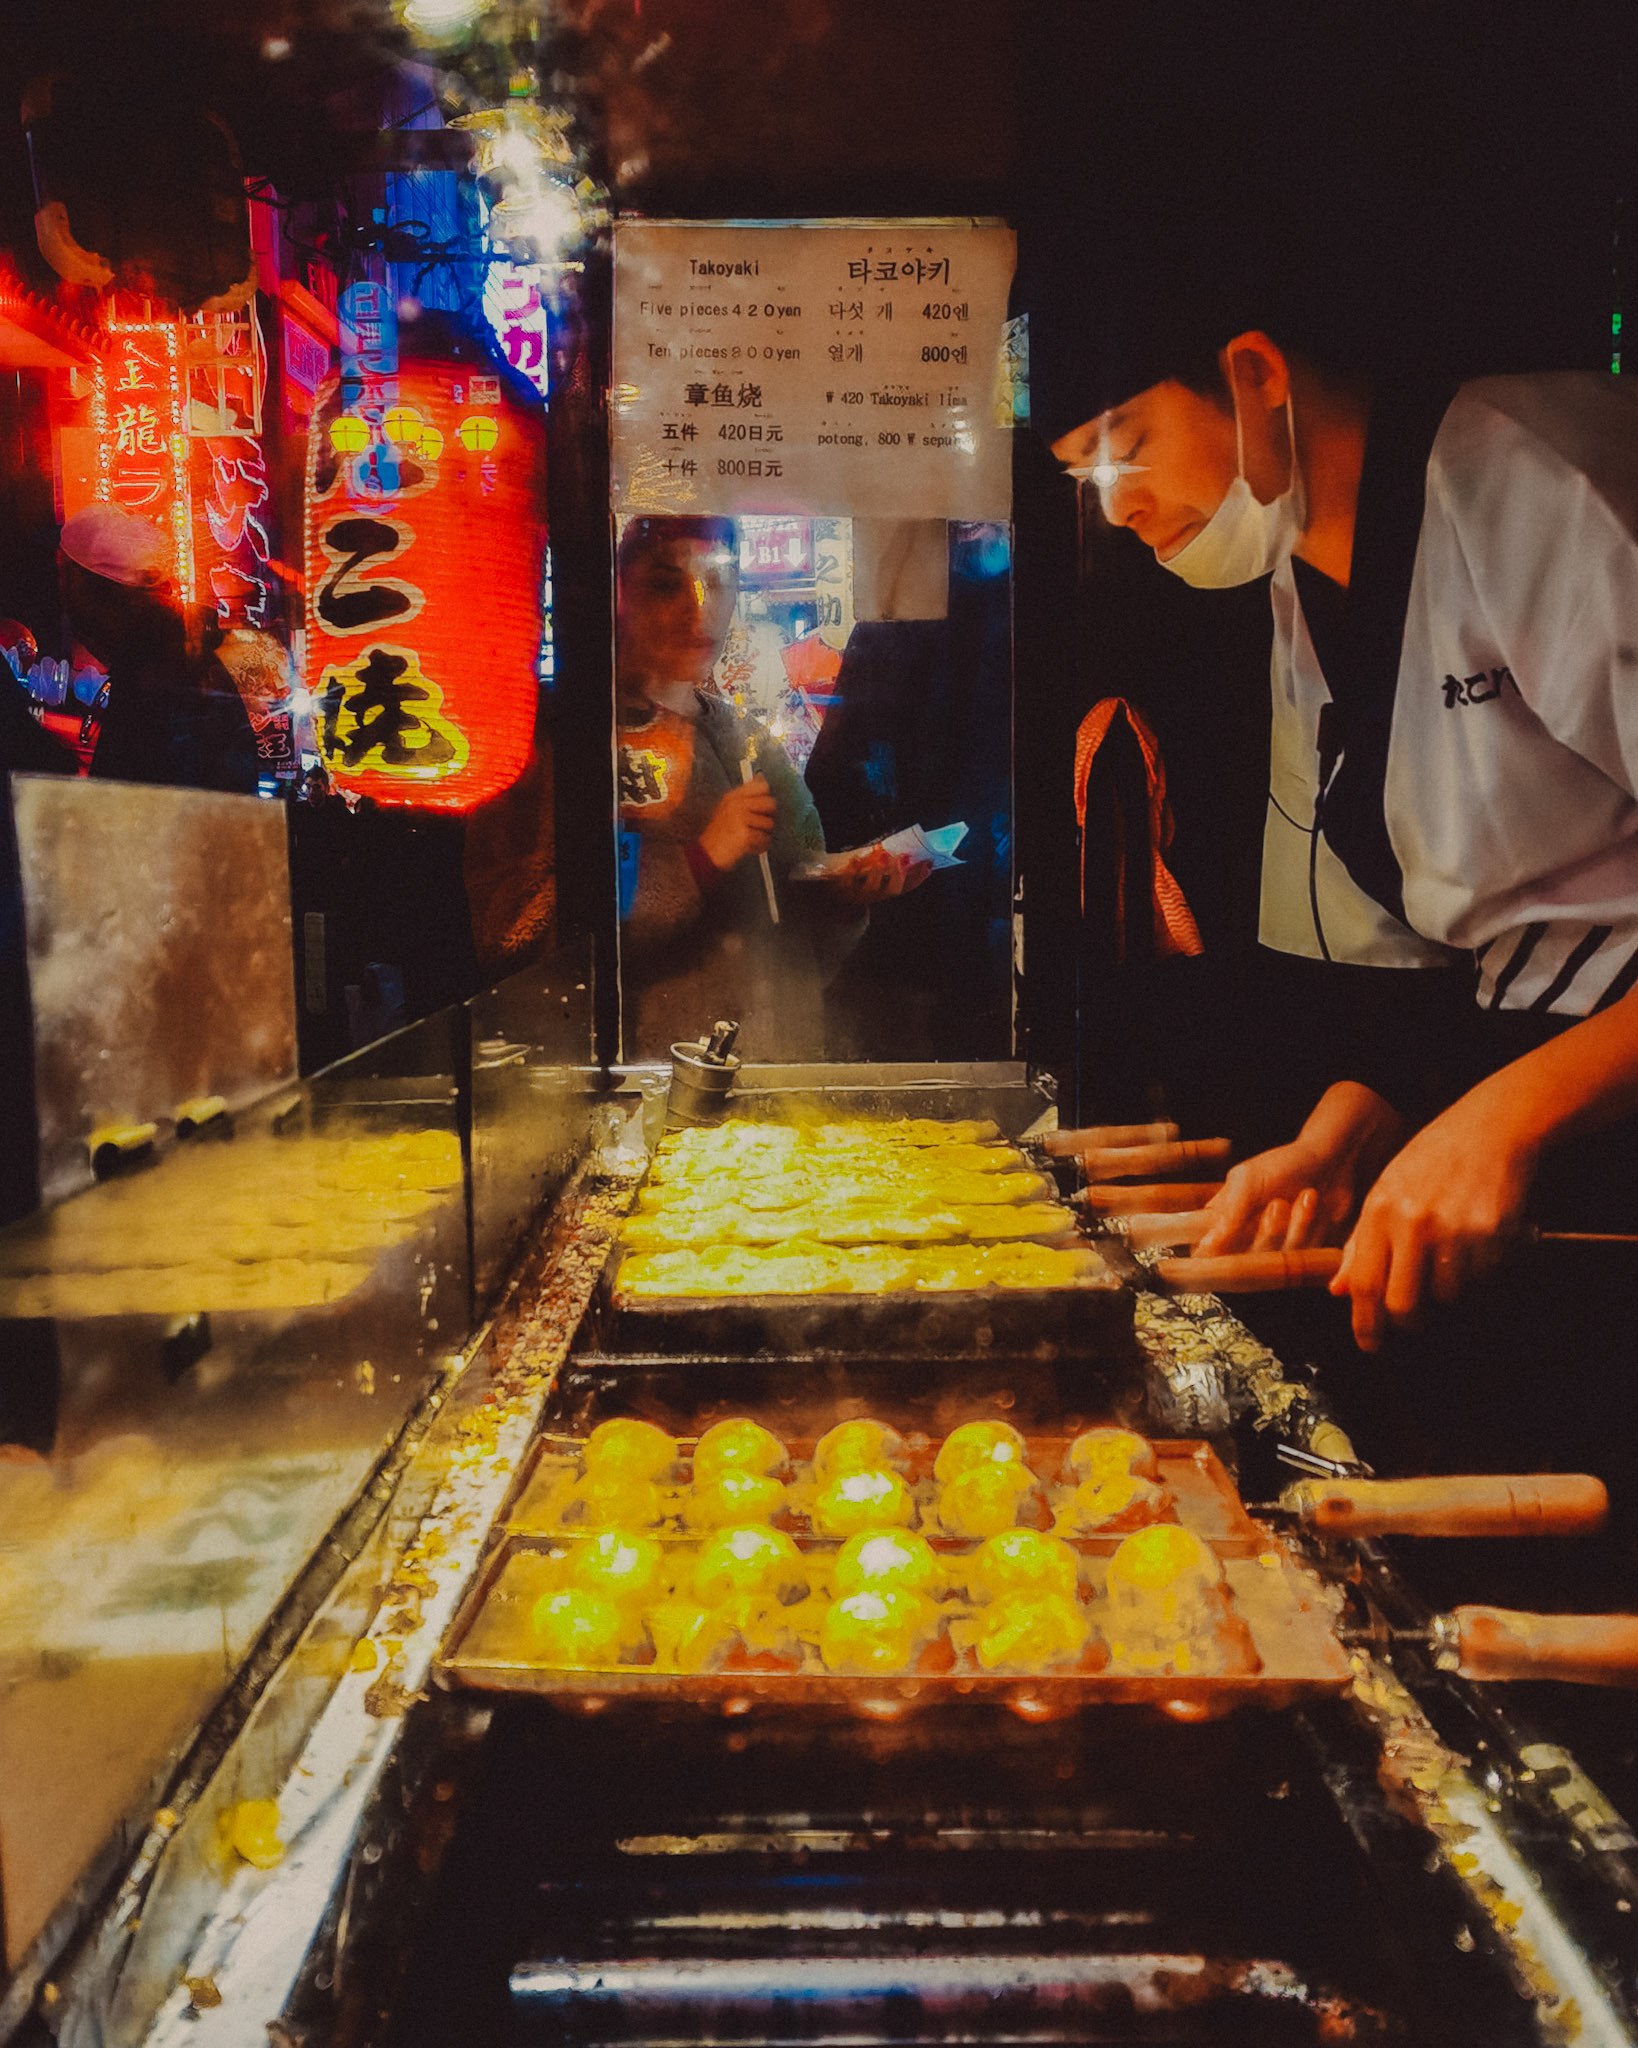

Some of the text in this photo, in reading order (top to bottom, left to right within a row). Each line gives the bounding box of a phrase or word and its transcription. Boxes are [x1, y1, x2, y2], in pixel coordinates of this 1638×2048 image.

[689, 259, 760, 277] Takoyaki
[848, 257, 951, 285] 타코야키
[640, 301, 673, 316] Five
[829, 301, 864, 321] 다섯
[876, 301, 893, 322] 개
[648, 342, 671, 357] Ten
[684, 381, 763, 409] 章鱼烧
[841, 392, 864, 405] 420
[871, 391, 929, 407] Takoyaki
[662, 422, 784, 442] 五件 420日元
[878, 432, 901, 445] 800
[662, 458, 784, 477] 十件 800日元
[758, 546, 780, 564] B1
